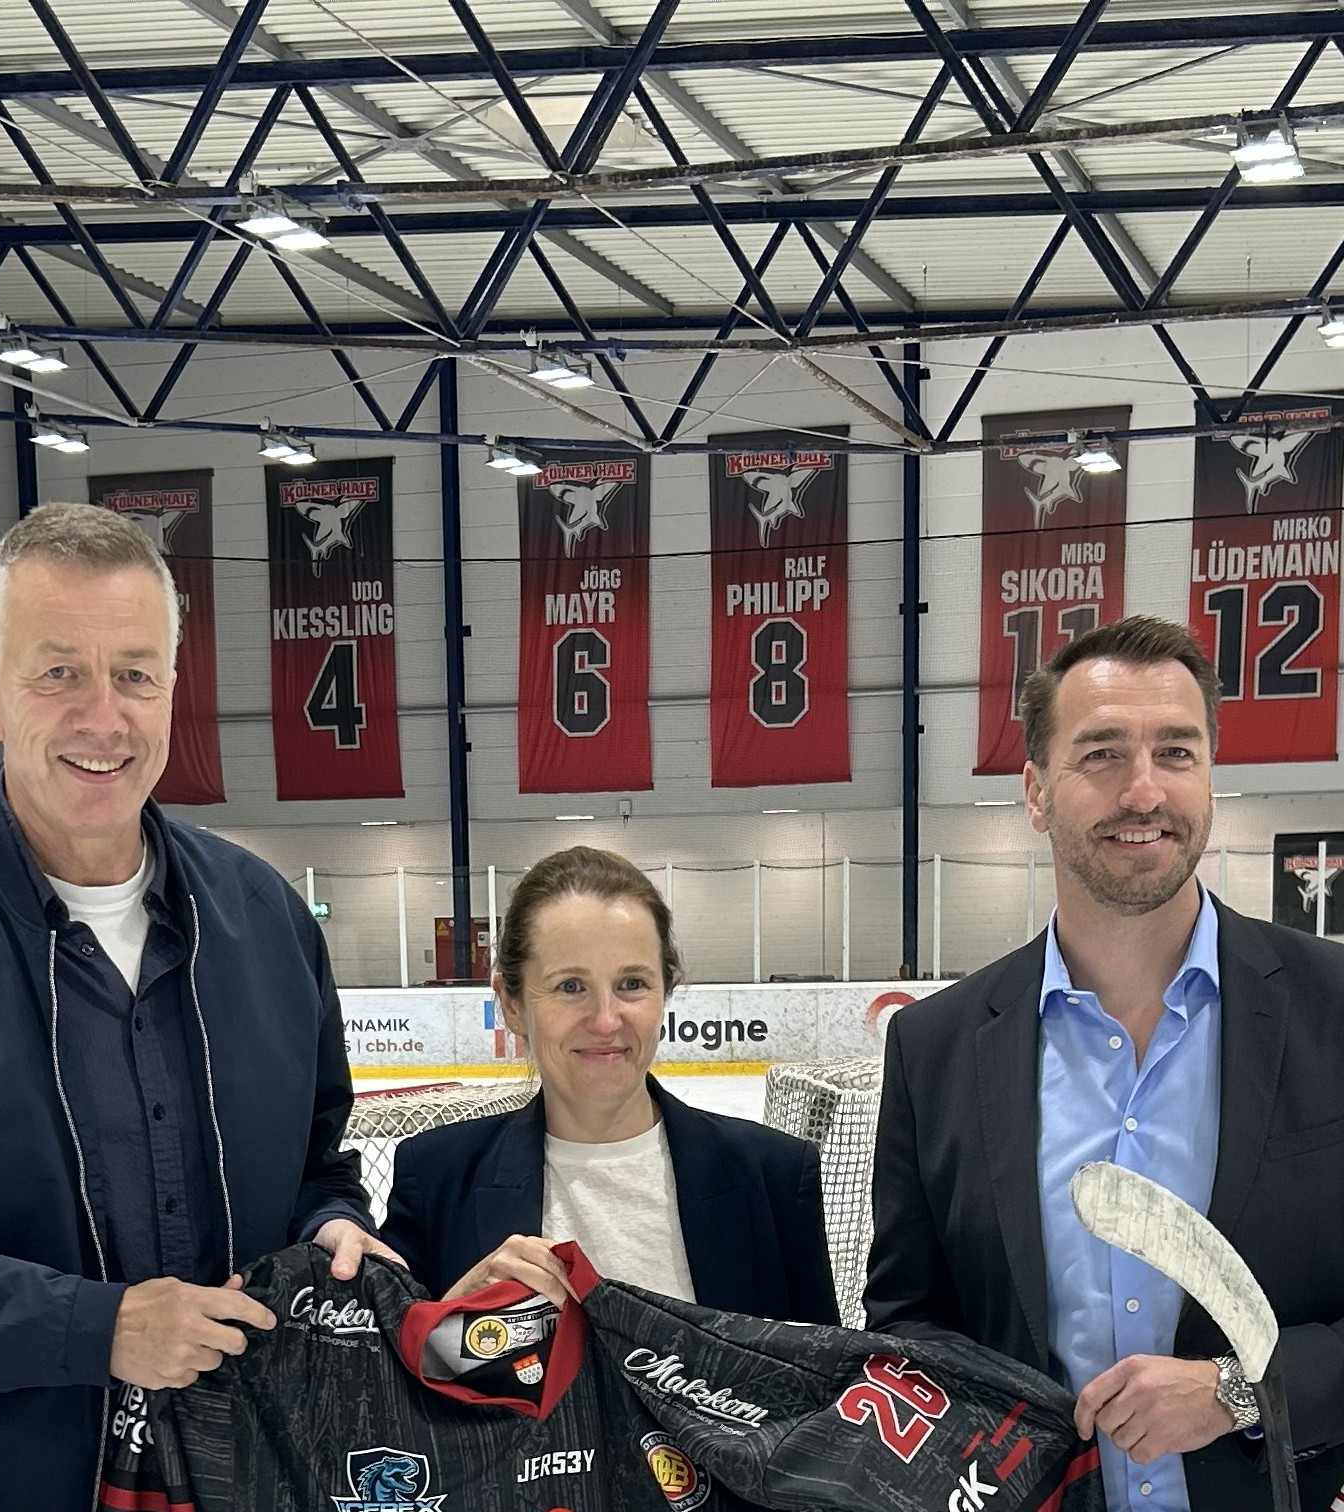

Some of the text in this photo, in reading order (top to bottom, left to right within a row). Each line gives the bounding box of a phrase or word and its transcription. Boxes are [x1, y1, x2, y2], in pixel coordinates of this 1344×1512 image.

[597, 463, 633, 482] HAIE
[160, 490, 197, 509] HAIE
[340, 480, 377, 498] HAIE
[1272, 516, 1331, 541] MIRKO
[785, 556, 826, 579] RALF
[1061, 542, 1106, 565] MIRO
[1191, 540, 1340, 582] LÜDEMANN
[352, 581, 383, 602] UDO
[580, 566, 621, 590] JÖRG
[1001, 566, 1104, 603] SIKORA
[545, 591, 616, 626] MAYR
[727, 578, 830, 616] PHILIPP
[273, 603, 394, 640] KIESSLING
[1204, 580, 1324, 701] 12
[552, 627, 612, 738] 6
[749, 617, 809, 729] 8
[303, 640, 367, 750] 4
[343, 1018, 410, 1032] YNAMIK
[366, 1038, 424, 1052] cbh.de
[836, 1352, 951, 1464] 26
